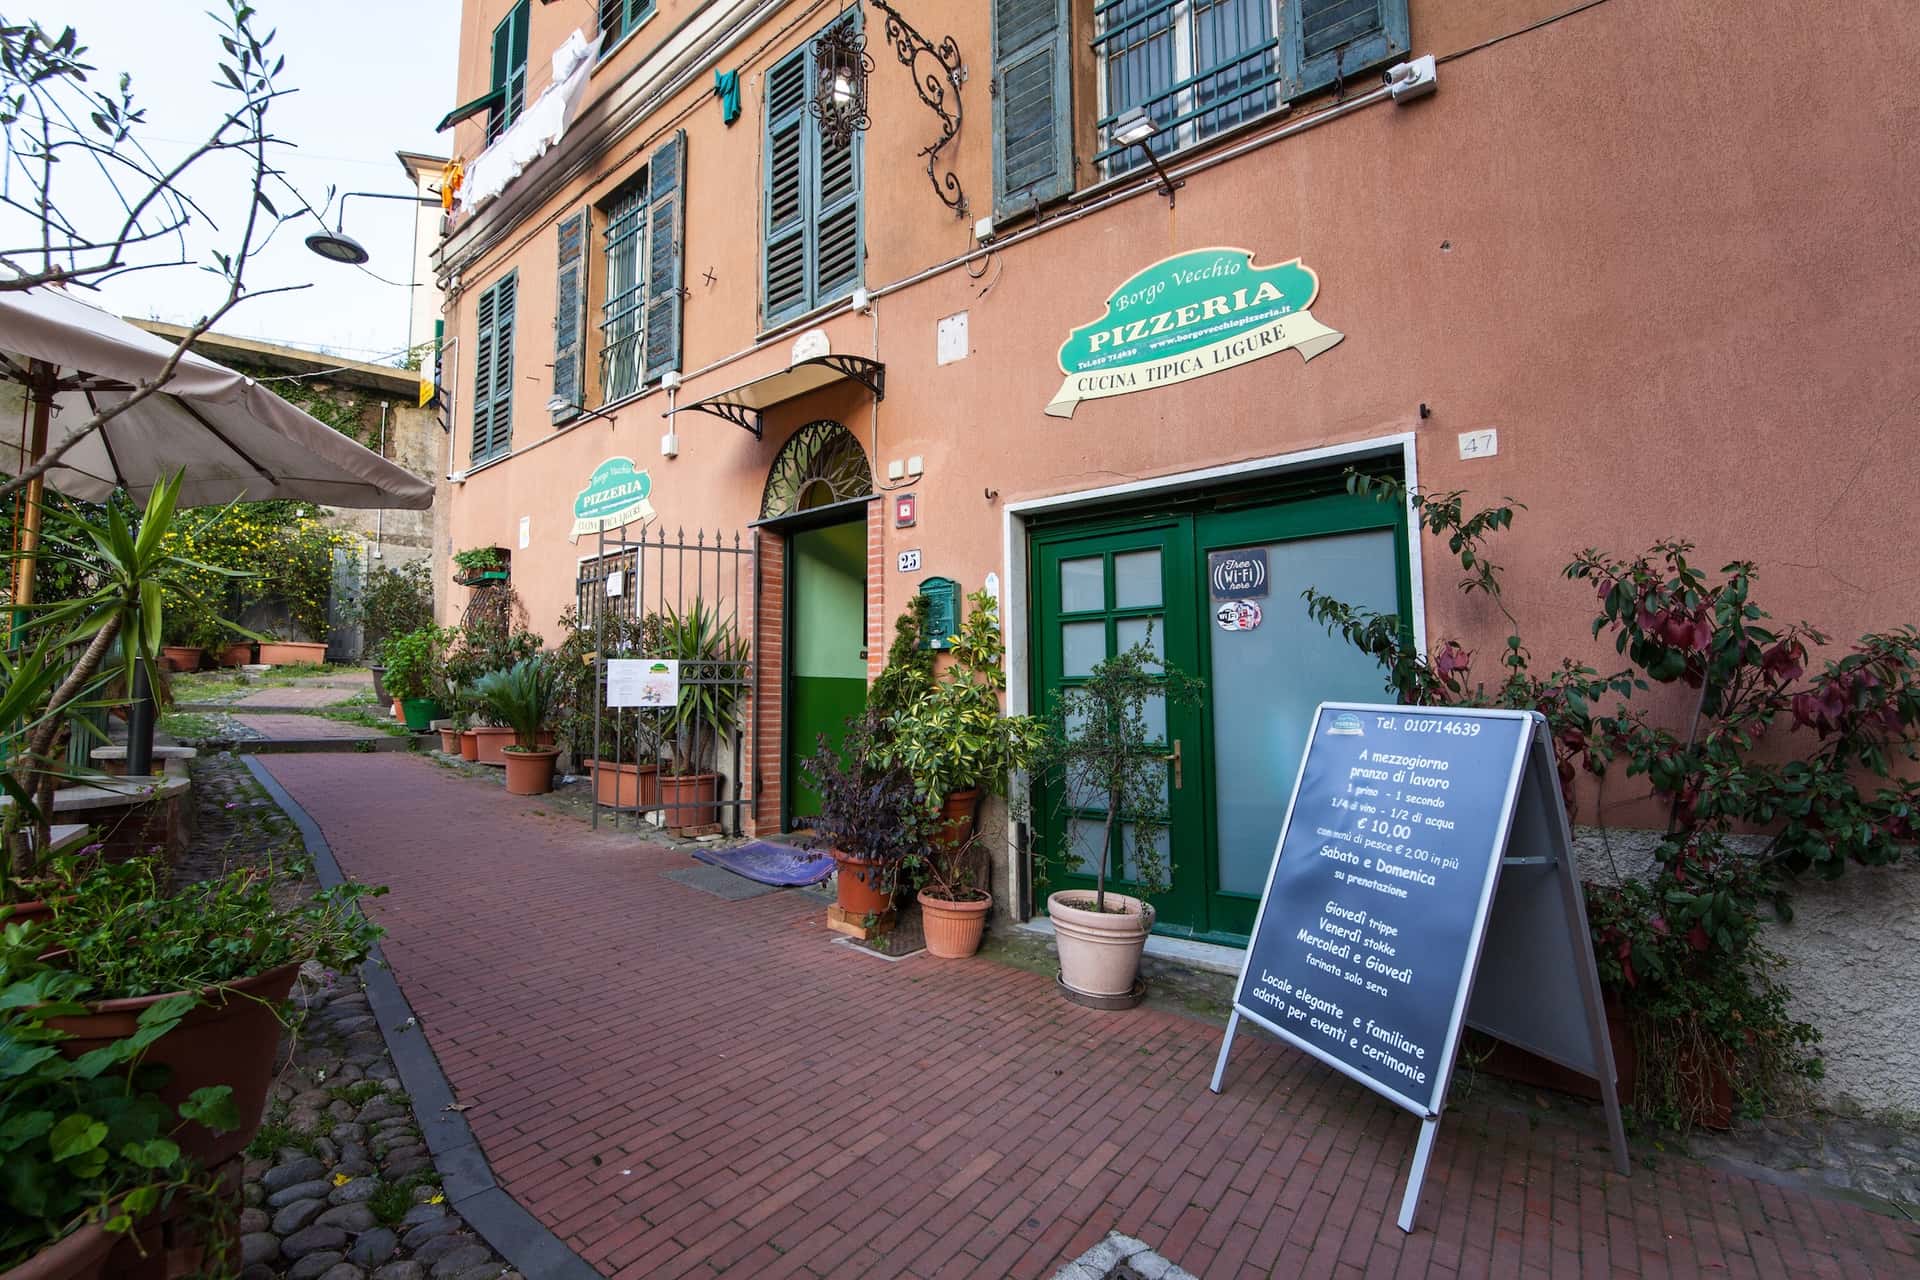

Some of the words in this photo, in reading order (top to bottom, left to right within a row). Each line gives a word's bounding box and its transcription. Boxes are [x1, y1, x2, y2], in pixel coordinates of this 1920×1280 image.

[1116, 281, 1166, 312] Borgo
[1172, 257, 1241, 287] Vecchio
[1088, 282, 1285, 353] PIZZERIA
[1150, 305, 1291, 350] www.borgovecchiopizzeria.it
[1078, 371, 1137, 392] CUCINA
[1145, 356, 1203, 382] TIPICA
[1213, 324, 1286, 364] LIGURE
[1464, 433, 1493, 453] 47
[583, 480, 642, 508] PIZZERIA
[901, 553, 918, 570] 25
[1225, 559, 1251, 570] Free
[1229, 582, 1251, 591] here
[1376, 717, 1397, 731] Tel.
[1404, 719, 1481, 736] 010714639
[1359, 749, 1368, 760] A
[1372, 752, 1449, 771] mezzogiorno
[1347, 783, 1353, 793] 1
[1395, 791, 1401, 801] 1
[1405, 793, 1445, 808] secondo
[1350, 766, 1389, 781] pranzo
[1393, 770, 1406, 783] di
[1409, 772, 1450, 790] lavoro
[1331, 797, 1349, 810] 1/4
[1359, 802, 1376, 814] vino
[1390, 807, 1409, 820] 1/2
[1412, 812, 1422, 823] di
[1425, 817, 1455, 831] acqua
[1357, 817, 1368, 830] €
[1371, 820, 1411, 840] 10,00
[1320, 845, 1359, 865] Sabato
[1363, 858, 1372, 868] e
[1376, 858, 1436, 886] Domenica
[1353, 833, 1362, 844] di
[1364, 838, 1393, 853] pesce
[1395, 844, 1404, 855] €
[1430, 852, 1441, 866] in
[1442, 857, 1460, 870] più
[1334, 869, 1344, 880] su
[1346, 873, 1408, 898] prenotazione
[1325, 900, 1367, 925] Giovedì
[1369, 918, 1398, 937] trippe
[1319, 917, 1362, 943] Venerdì
[1363, 937, 1396, 957] stokke
[1296, 928, 1351, 959] Mercoledì
[1353, 953, 1361, 963] e
[1365, 955, 1413, 984] Giovedì
[1305, 953, 1341, 977] farinata
[1344, 972, 1363, 986] solo
[1365, 981, 1388, 997] sera
[1261, 968, 1293, 994] Locale
[1295, 988, 1344, 1019] elegante
[1352, 1016, 1361, 1028] e
[1365, 1020, 1425, 1060] familiare
[1252, 987, 1286, 1010] adatto
[1287, 1004, 1307, 1021] per
[1310, 1017, 1347, 1043] eventi
[1349, 1037, 1359, 1049] e
[1361, 1043, 1426, 1084] cerimonie
